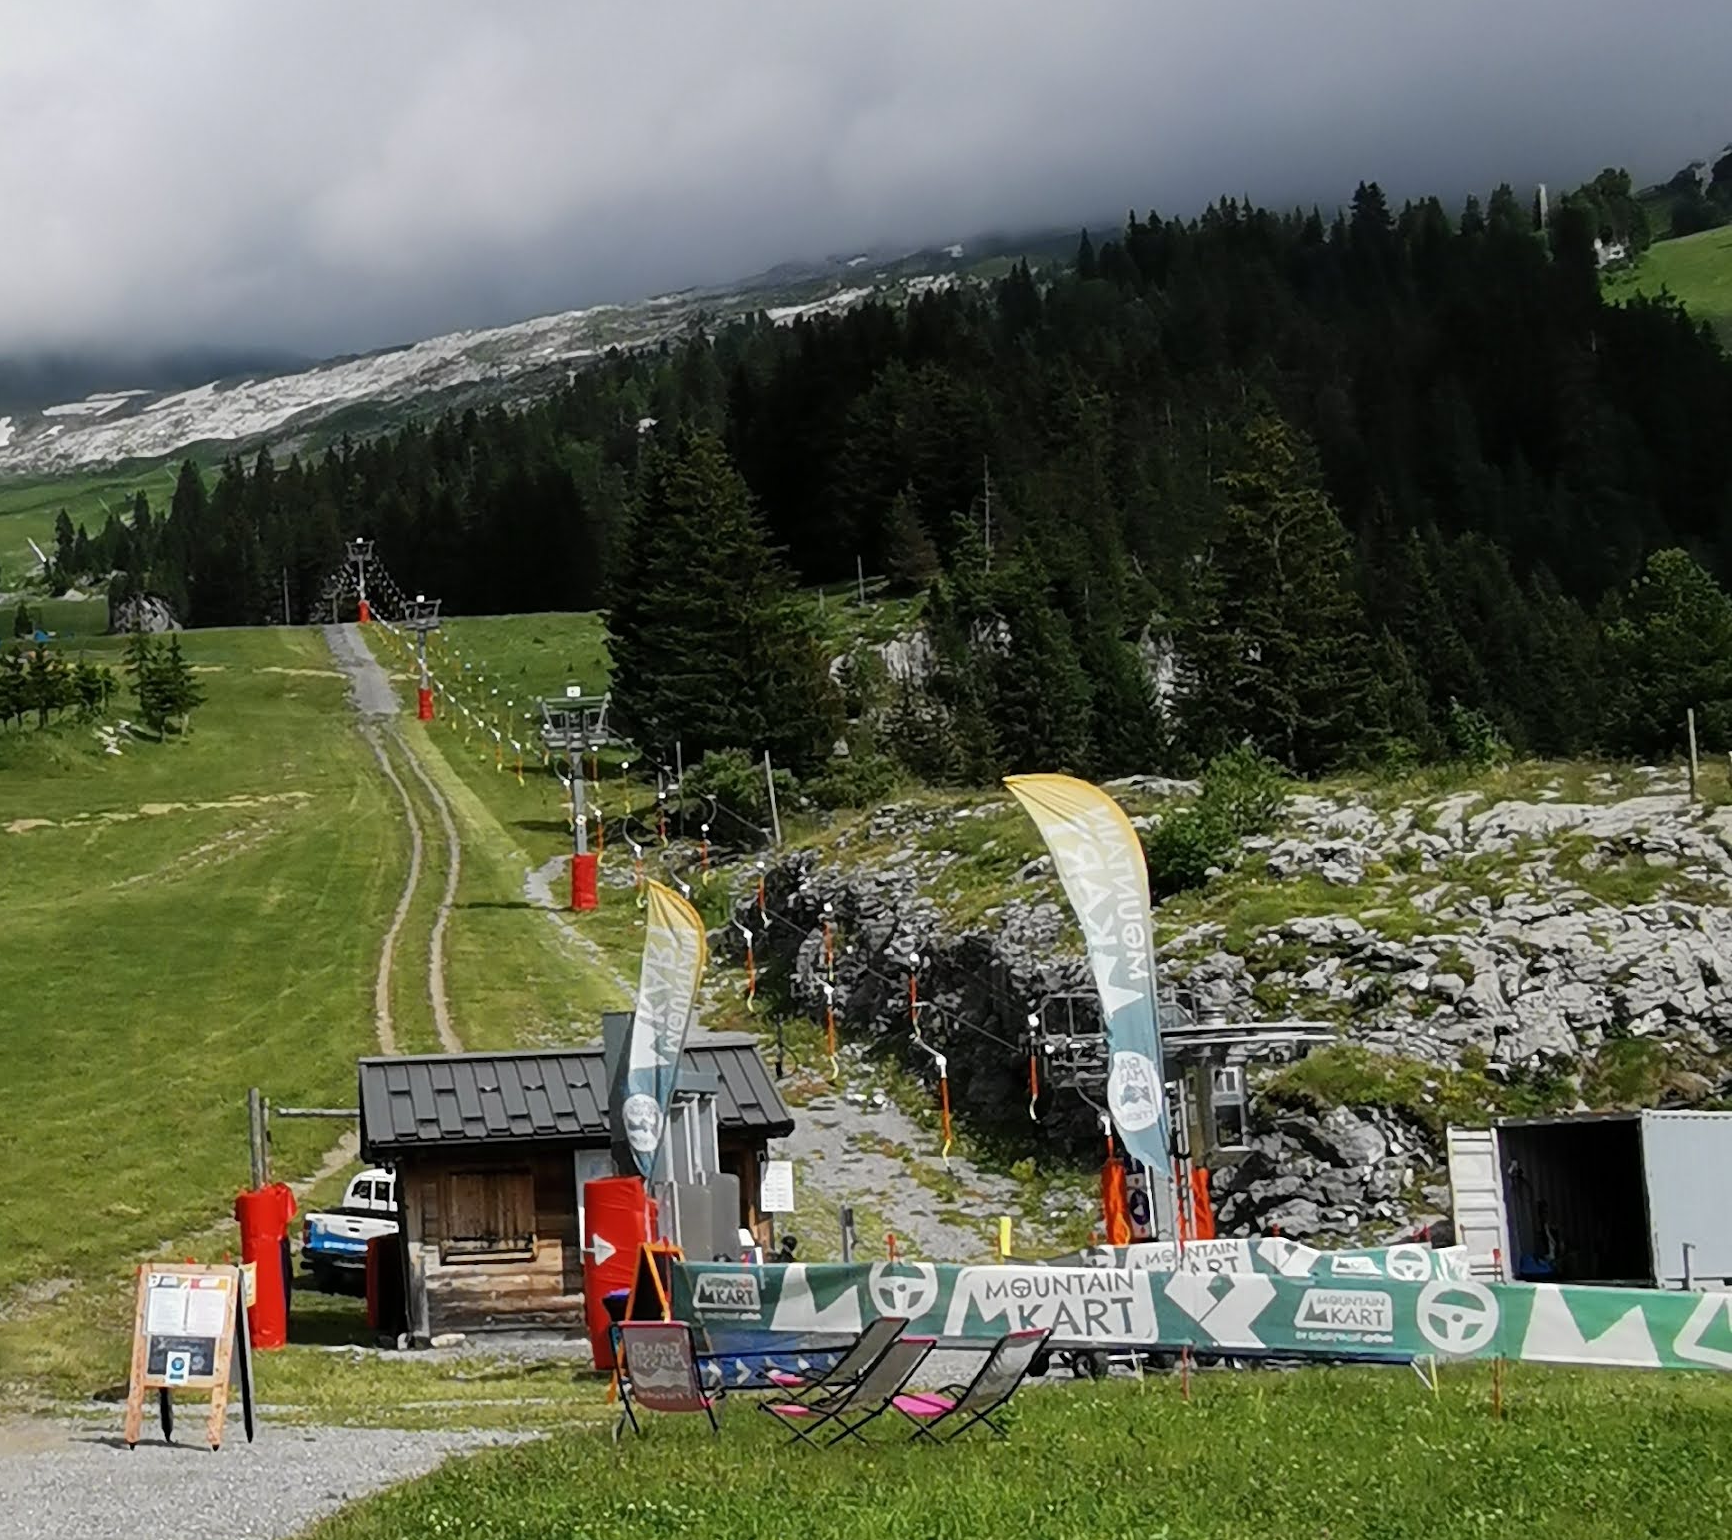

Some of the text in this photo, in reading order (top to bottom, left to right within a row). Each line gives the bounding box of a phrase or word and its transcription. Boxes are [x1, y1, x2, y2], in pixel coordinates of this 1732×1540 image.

[1146, 1242, 1239, 1264] MONTAIN
[984, 1270, 1135, 1300] MOUNTAIN
[717, 1289, 754, 1305] KART
[1317, 1295, 1386, 1306] MOUNTAIN
[1017, 1297, 1134, 1336] KART
[1331, 1308, 1384, 1326] KART
